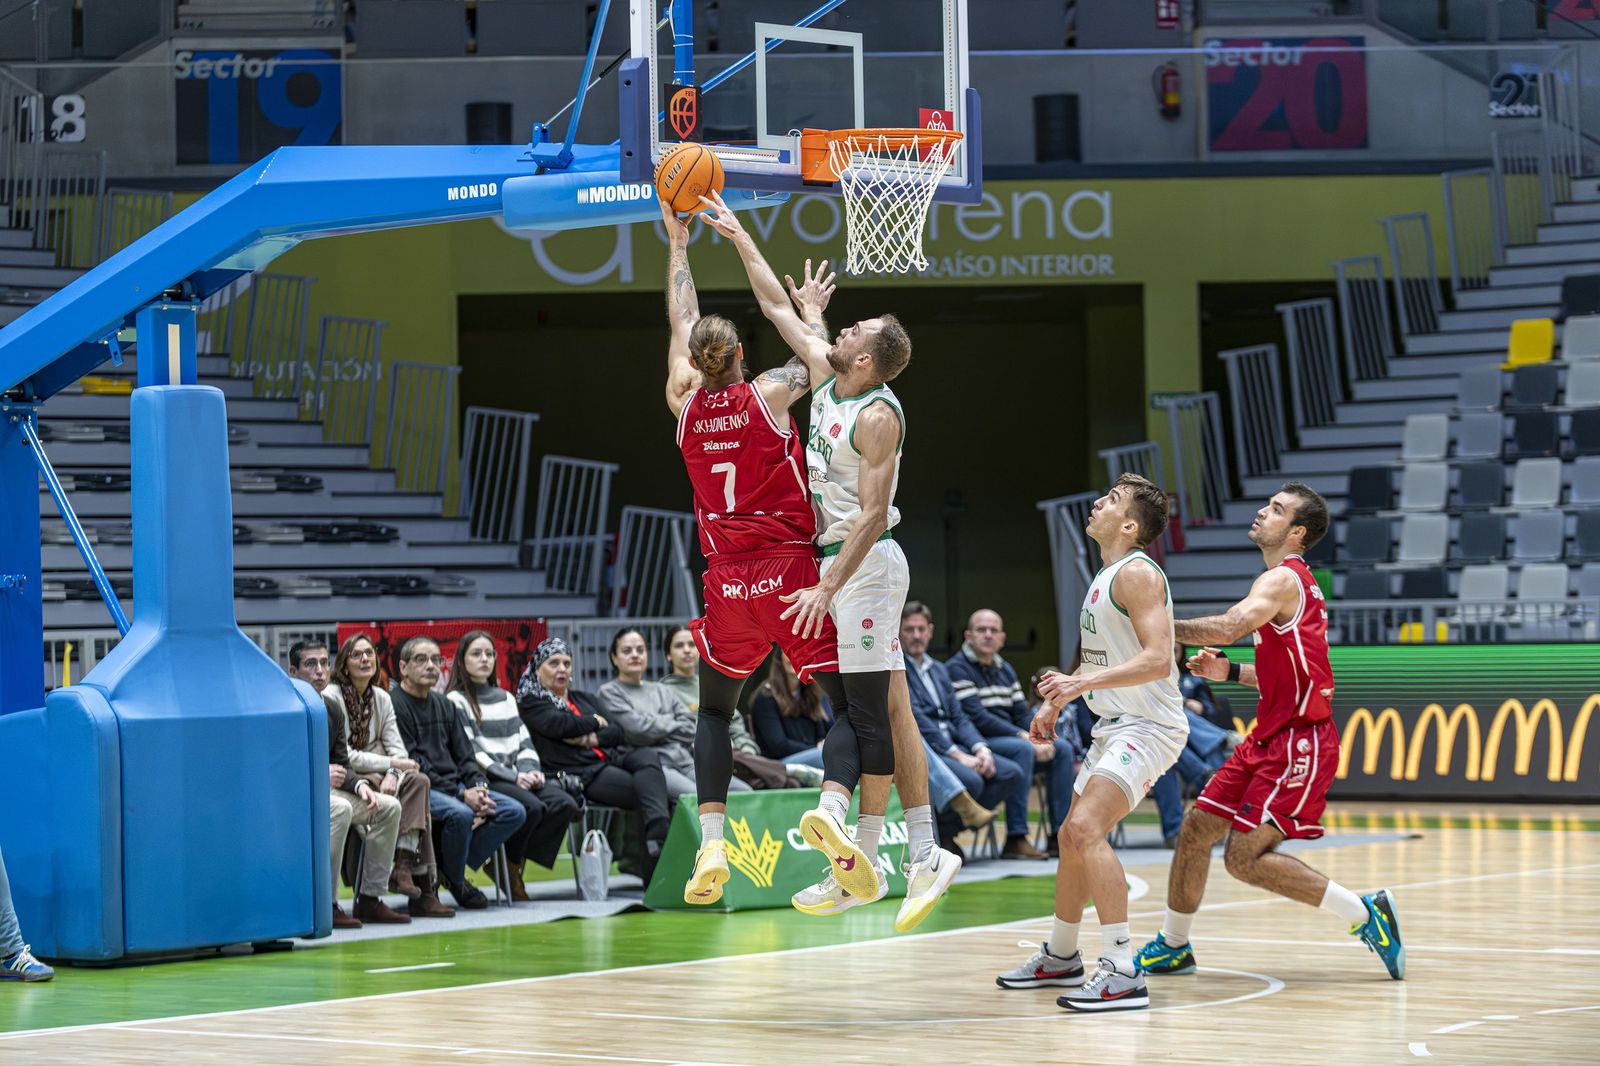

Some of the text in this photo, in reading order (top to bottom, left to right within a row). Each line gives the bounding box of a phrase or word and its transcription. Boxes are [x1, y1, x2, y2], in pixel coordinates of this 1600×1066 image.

[175, 52, 281, 79] Sector
[1204, 40, 1304, 67] Sector
[177, 49, 342, 165] 19
[1206, 38, 1368, 151] 20
[448, 182, 498, 201] MONDO
[590, 184, 652, 204] MONDO
[1001, 254, 1114, 277] INTERIOR
[711, 462, 736, 513] 7
[750, 574, 783, 597] ACM
